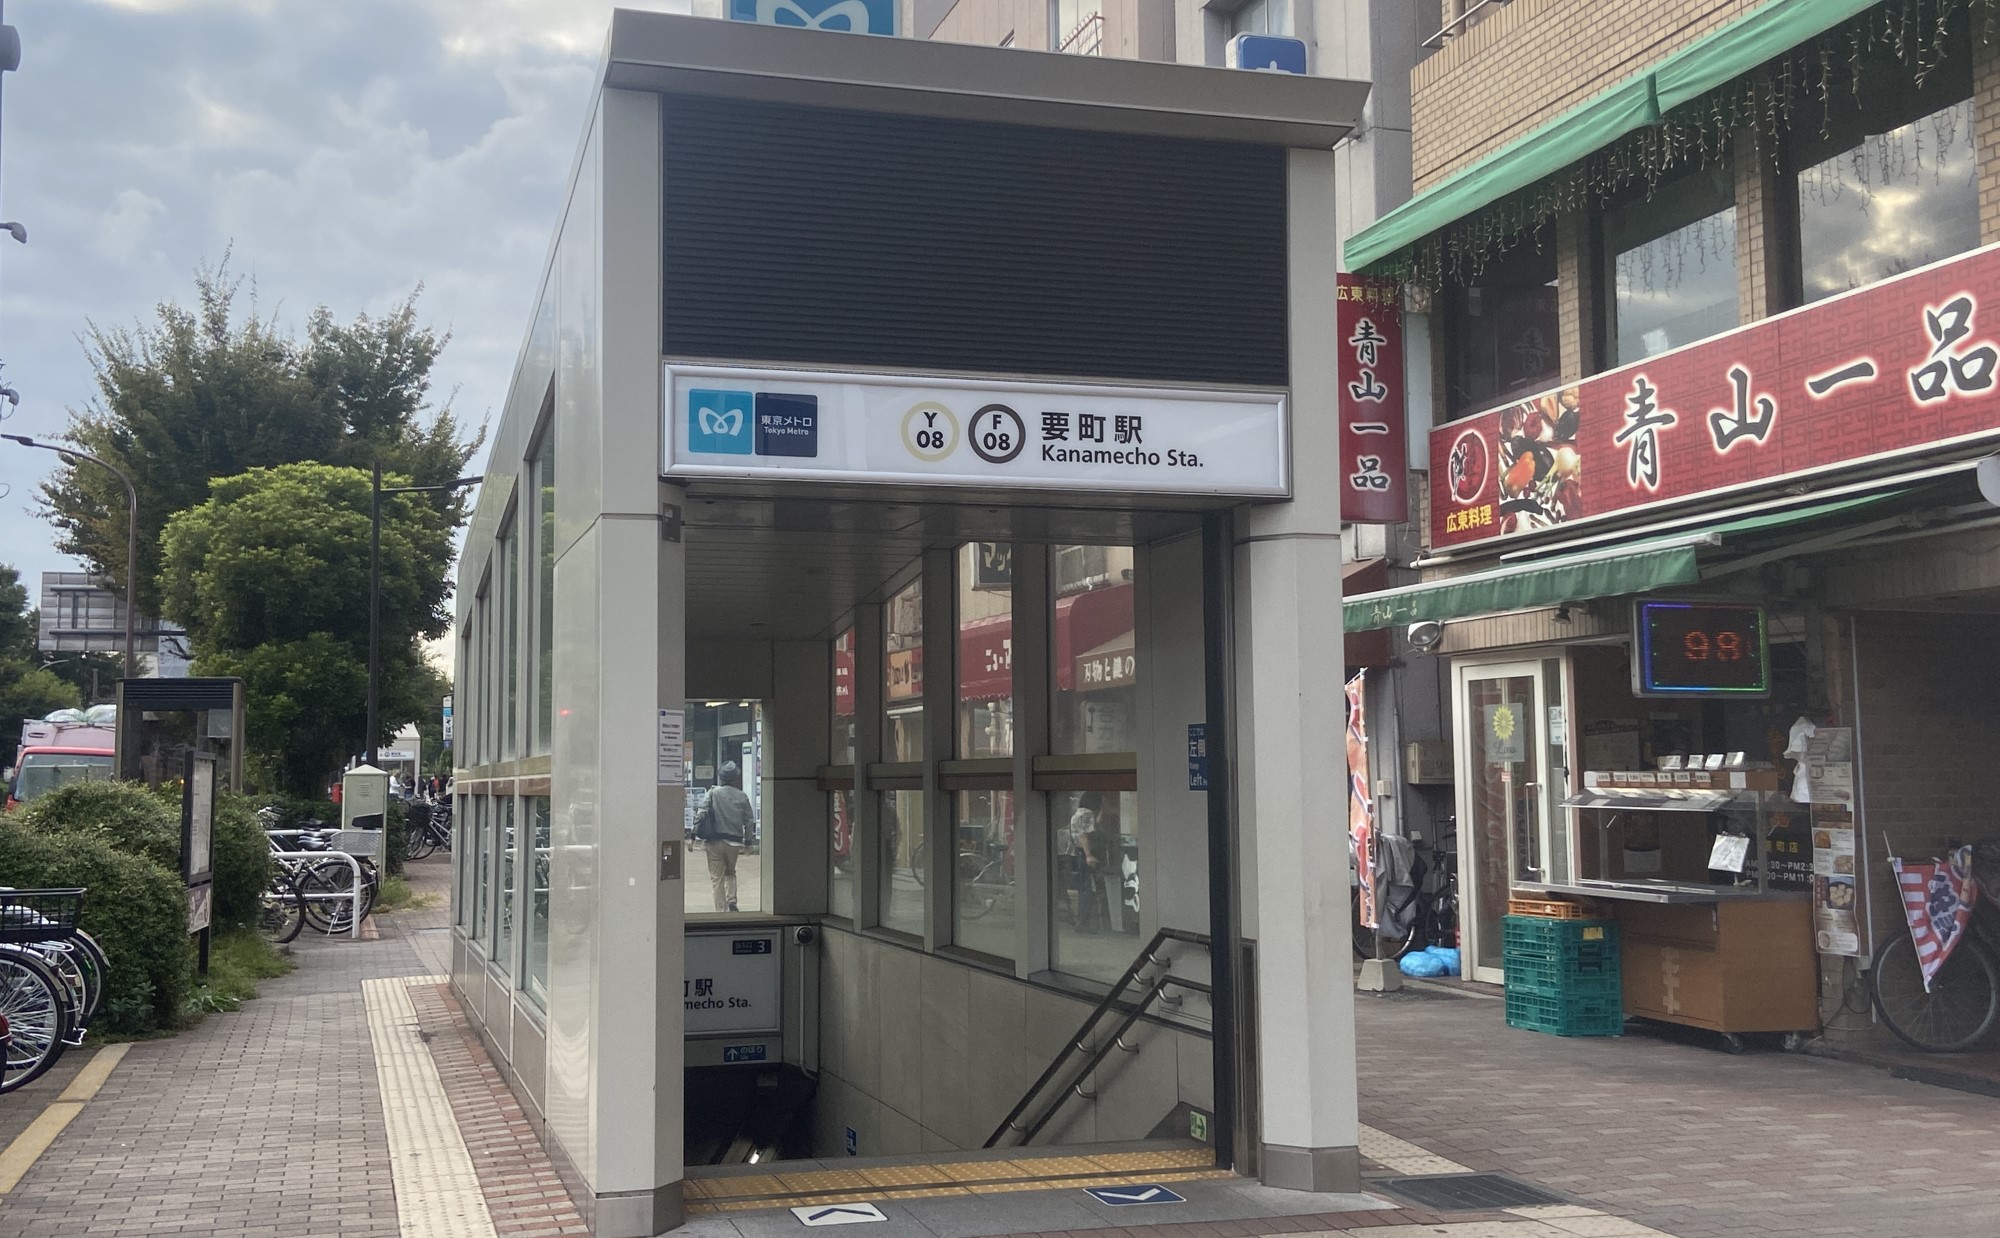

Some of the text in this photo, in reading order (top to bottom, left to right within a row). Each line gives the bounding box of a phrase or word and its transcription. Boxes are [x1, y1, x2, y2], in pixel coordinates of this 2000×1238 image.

[1614, 297, 1998, 488] 青山一品
[1351, 320, 1389, 489] 青山一品
[761, 415, 812, 427] 東京メトロ
[923, 412, 937, 428] Y
[992, 415, 1002, 430] F
[1041, 412, 1143, 444] 要町駅
[764, 426, 809, 436] Tokyo Metro
[916, 431, 944, 449] 08
[983, 432, 1011, 451] 08
[1042, 445, 1204, 467] Kanamecho Sta.
[1446, 504, 1493, 533] 広東料理
[1371, 600, 1418, 624] 青山一品
[1190, 773, 1202, 786] Left
[758, 941, 765, 952] 3
[728, 997, 752, 1008] Sta.
